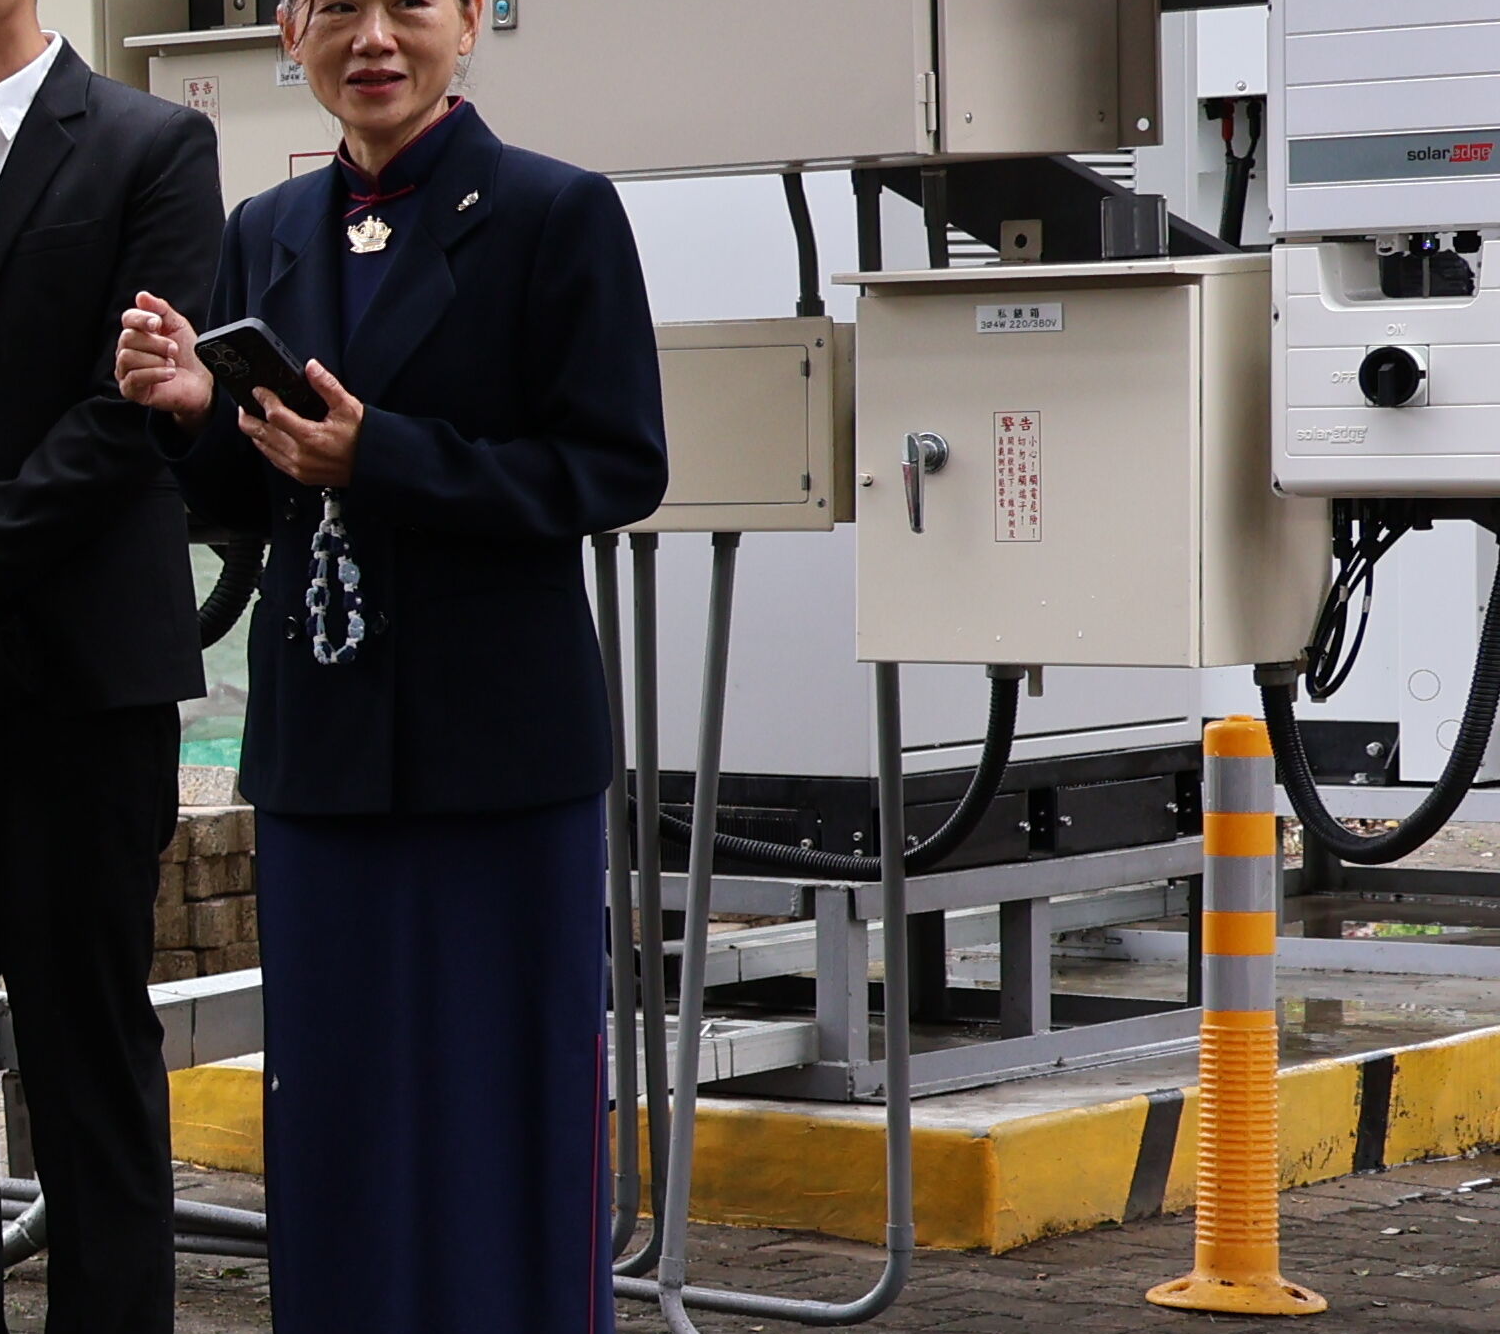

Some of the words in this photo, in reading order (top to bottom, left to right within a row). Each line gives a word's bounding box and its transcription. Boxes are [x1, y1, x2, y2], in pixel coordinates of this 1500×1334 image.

[1406, 143, 1494, 163] solaredge
[1385, 323, 1406, 336] ON
[1331, 371, 1357, 384] OFF
[1000, 416, 1034, 433] 警告
